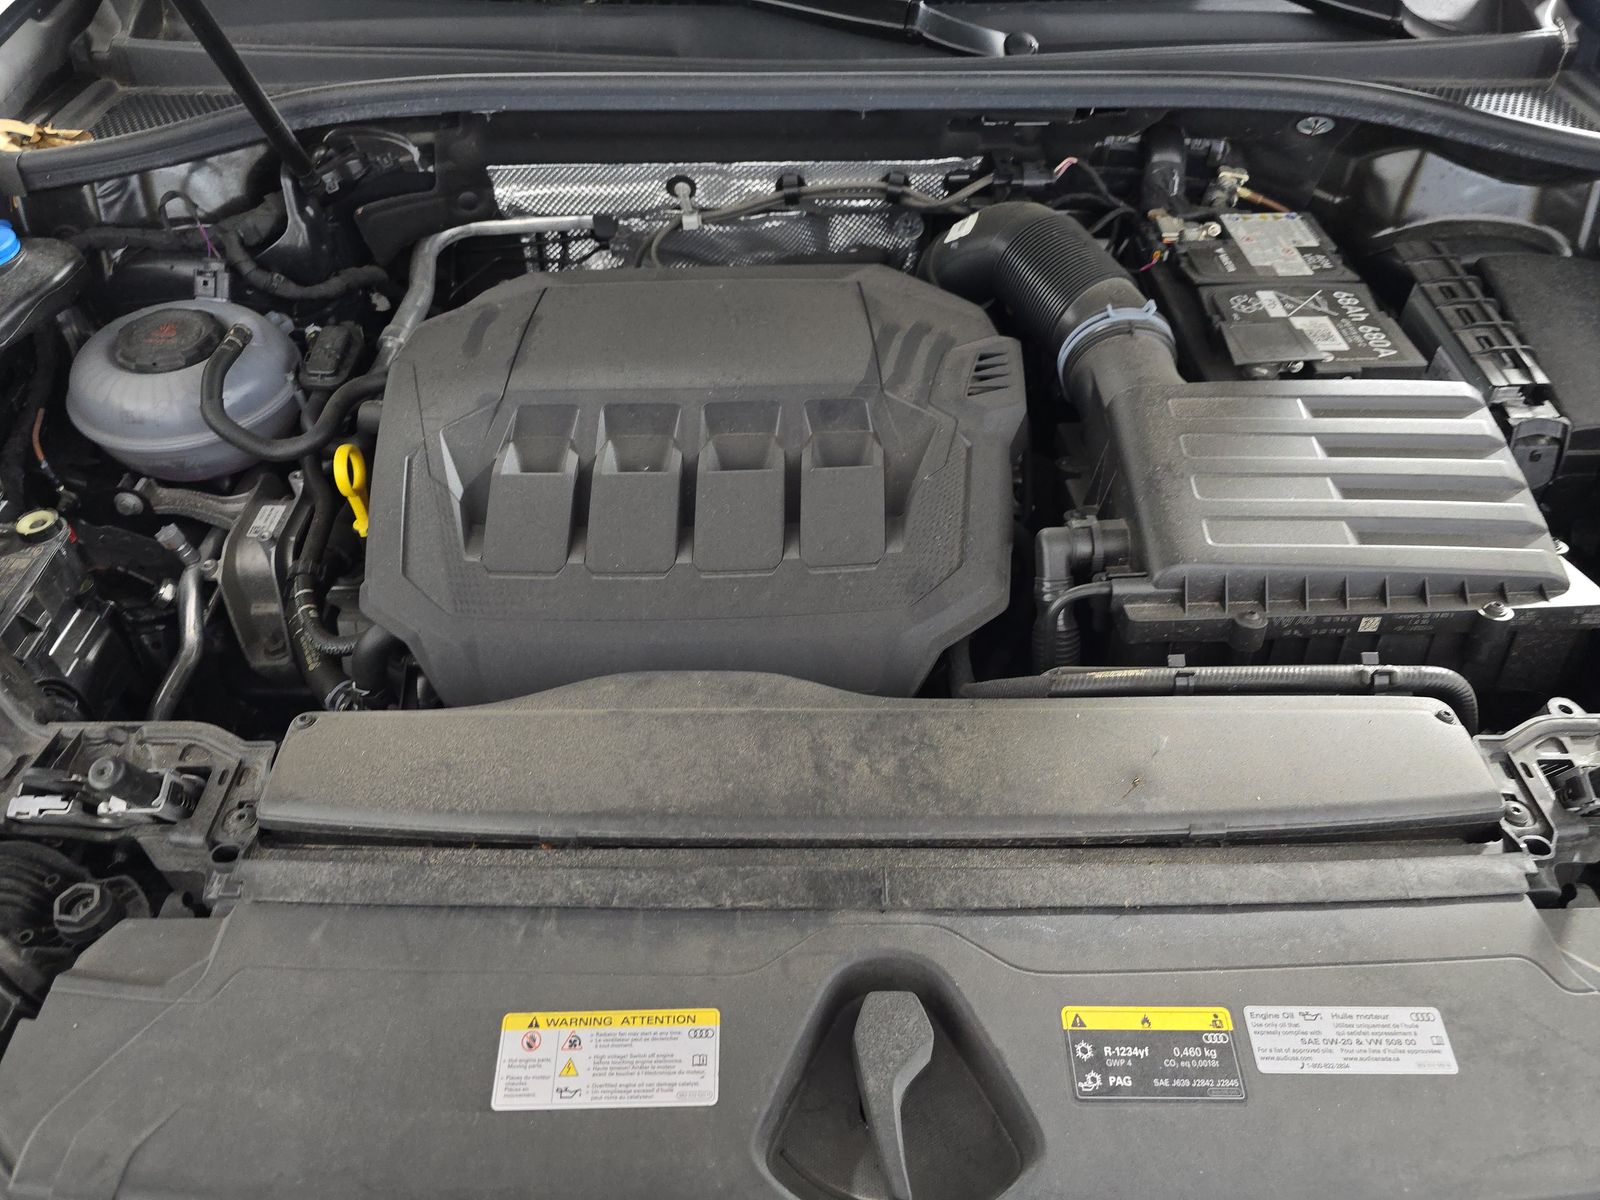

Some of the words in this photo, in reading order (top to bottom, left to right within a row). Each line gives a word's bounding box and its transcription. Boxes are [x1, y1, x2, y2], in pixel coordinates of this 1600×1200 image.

[1333, 291, 1370, 321] 68Ah
[1358, 325, 1398, 358] 680A
[1249, 1011, 1280, 1020] Engine
[1282, 1011, 1294, 1019] Oil
[1330, 1012, 1354, 1020] Huile
[546, 1016, 613, 1027] WARNING
[621, 1014, 697, 1025] ATTENTION
[1104, 1046, 1150, 1060] R-1234yf
[1173, 1046, 1203, 1058] 0,460
[1204, 1047, 1217, 1060] kg
[1105, 1059, 1126, 1067] GWP
[1126, 1059, 1133, 1067] 4
[1180, 1060, 1191, 1069] eq
[1108, 1076, 1133, 1087] PAG
[1153, 1078, 1170, 1087] SAE
[1171, 1078, 1191, 1087] J639
[1192, 1078, 1215, 1087] J2842
[1216, 1078, 1240, 1087] J2845
